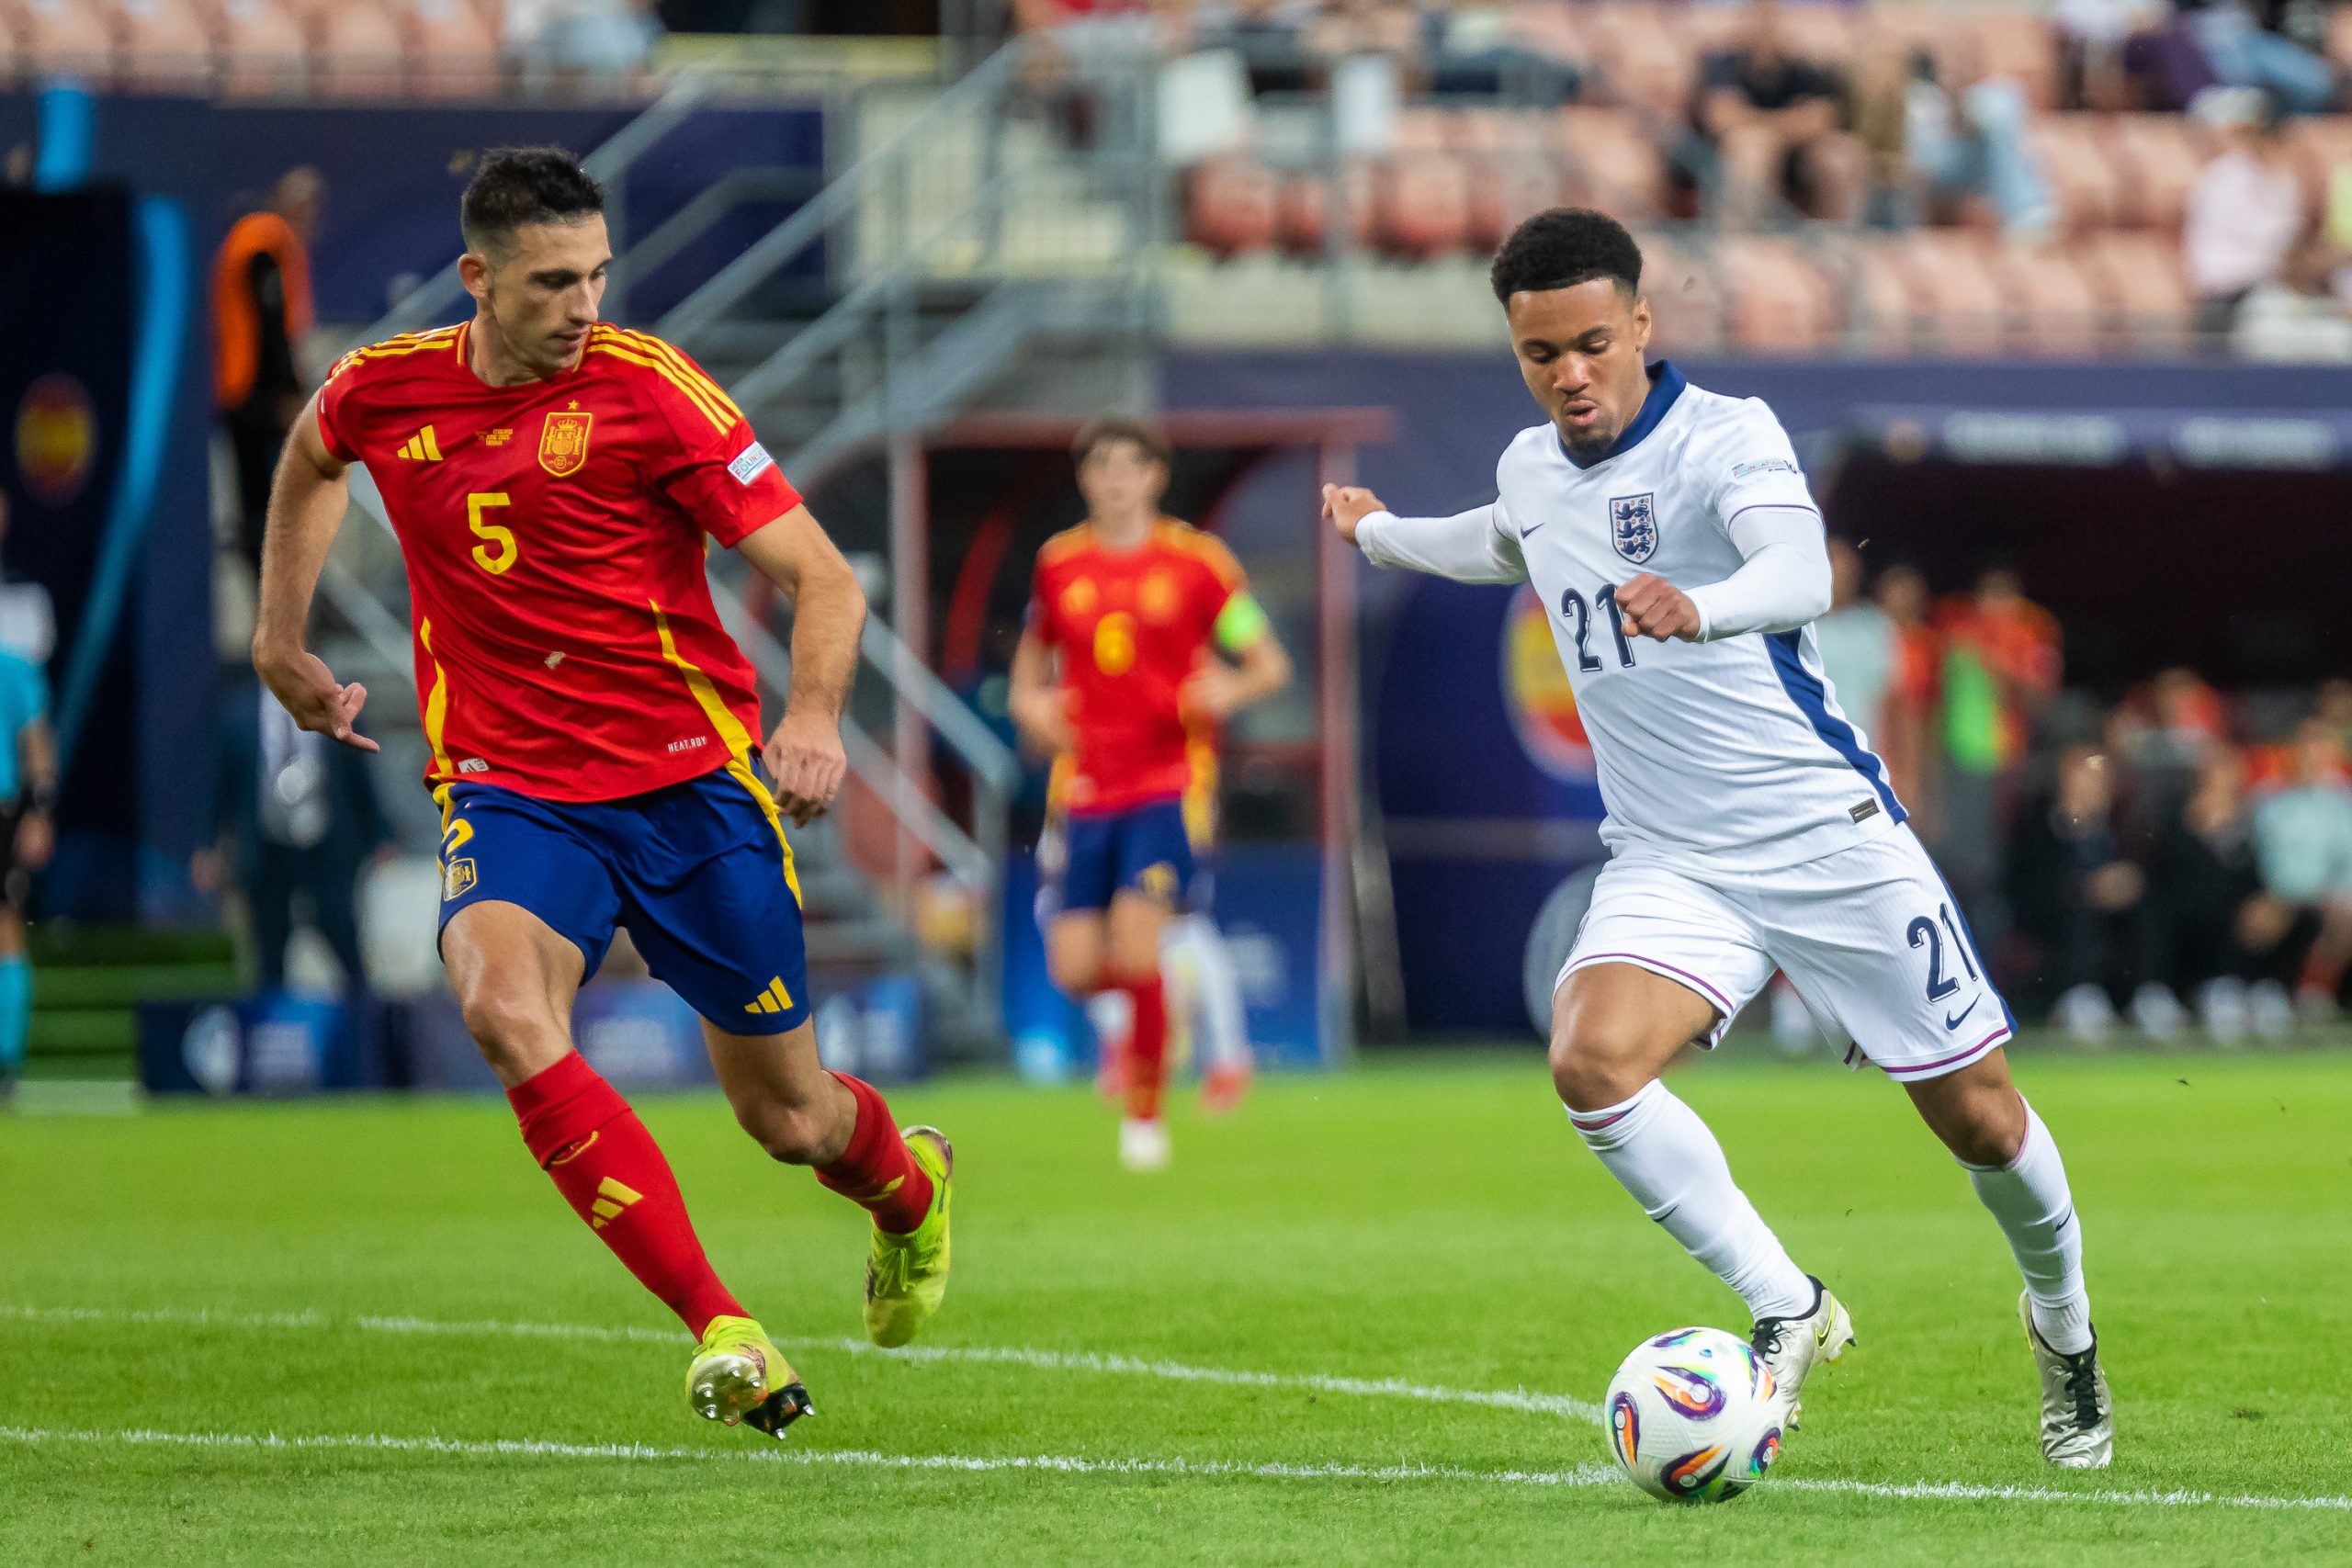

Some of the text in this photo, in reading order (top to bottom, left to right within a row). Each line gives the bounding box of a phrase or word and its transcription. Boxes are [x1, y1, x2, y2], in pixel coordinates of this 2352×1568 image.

[468, 492, 517, 575] 5
[1561, 583, 1636, 672] 21
[1906, 903, 1979, 1003] 21
